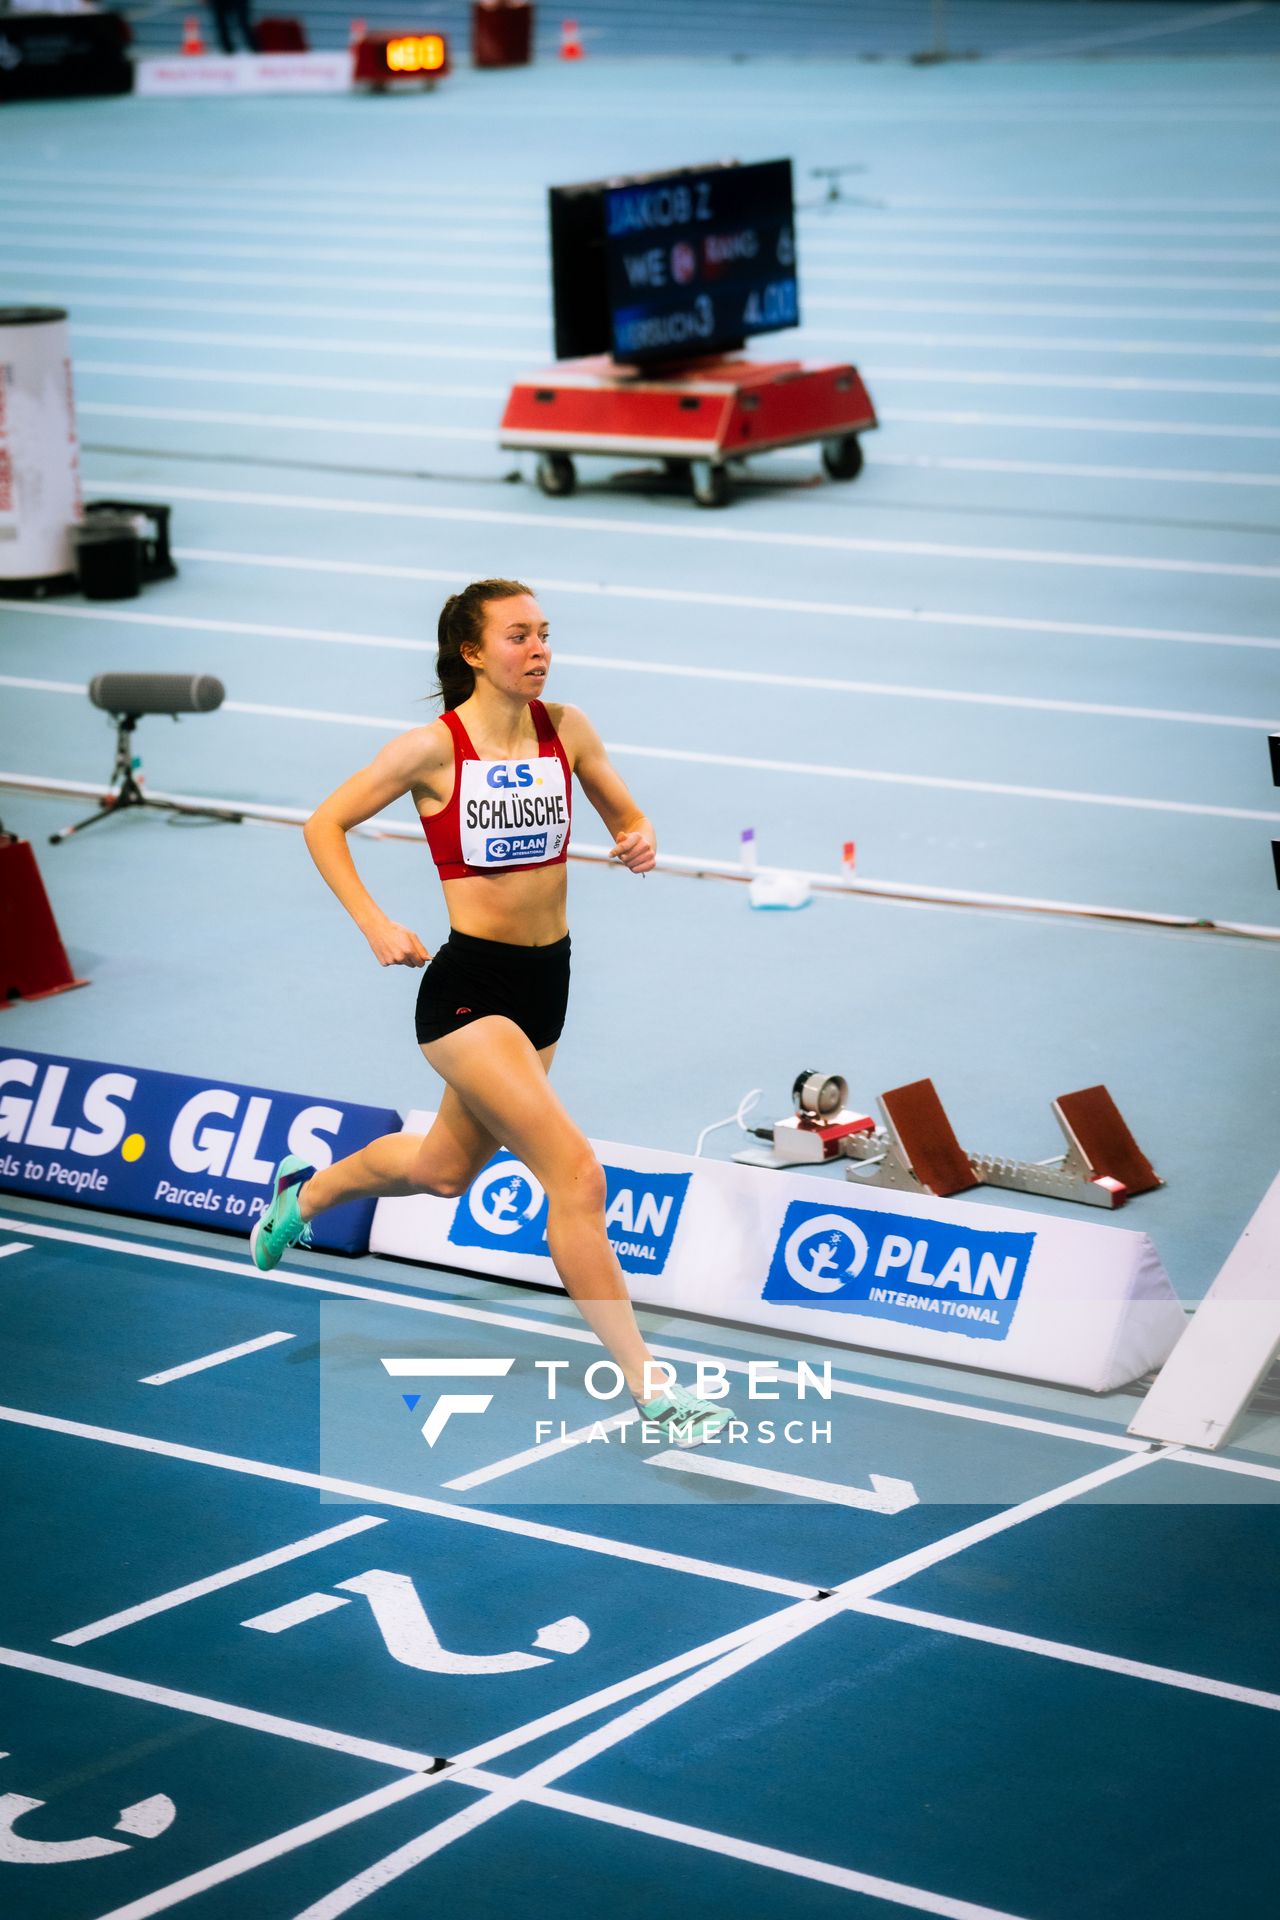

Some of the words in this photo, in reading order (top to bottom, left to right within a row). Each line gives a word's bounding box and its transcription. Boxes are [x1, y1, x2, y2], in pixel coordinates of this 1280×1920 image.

[466, 793, 566, 830] SCHLÜSCHE
[512, 837, 546, 851] PLAN
[512, 849, 545, 857] INTERNATIONAL
[24, 1160, 44, 1180] to
[45, 1162, 109, 1193] People
[154, 1180, 222, 1211] Parcels
[225, 1194, 246, 1215] to
[874, 1234, 1018, 1301] PLAN
[868, 1287, 1001, 1326] INTERNATIONAL
